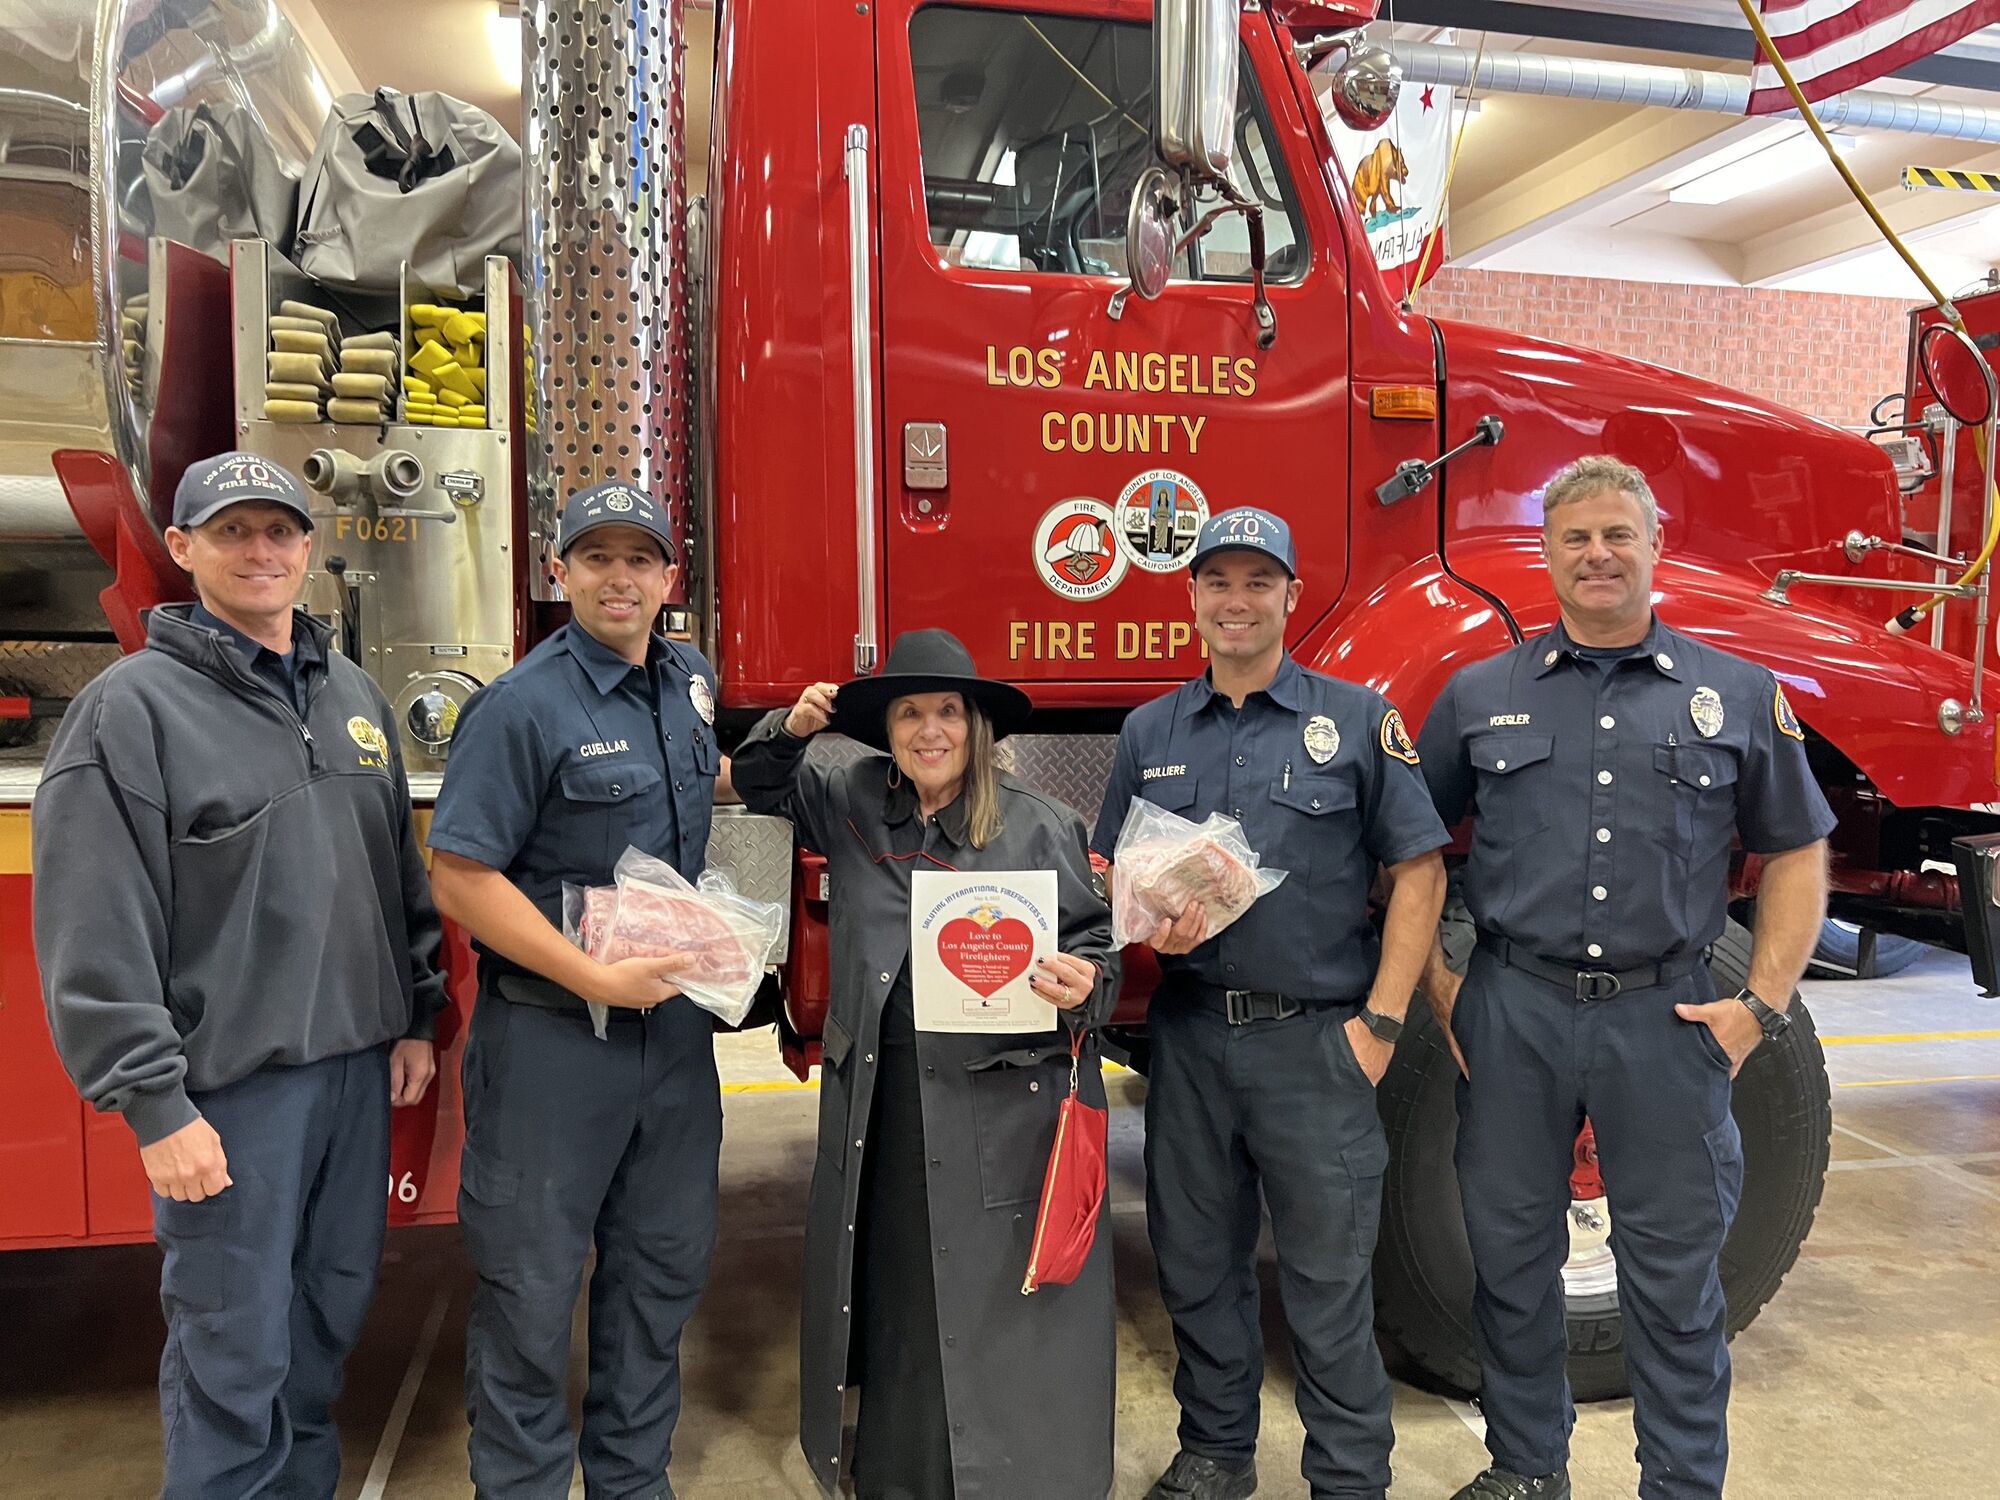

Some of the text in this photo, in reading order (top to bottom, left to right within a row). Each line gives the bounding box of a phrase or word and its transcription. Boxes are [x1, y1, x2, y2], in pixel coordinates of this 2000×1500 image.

[986, 345, 1257, 397] LOS ANGELES
[1041, 411, 1207, 454] COUNTY
[203, 456, 295, 491] LOS ANGELES COUNTY
[229, 464, 270, 481] 70
[218, 479, 248, 491] FIRE
[1121, 472, 1205, 507] COUNTY OF LOS ANGELES
[1073, 503, 1097, 513] FIRE
[336, 515, 417, 541] F0621
[1210, 520, 1222, 533] LOS
[1255, 513, 1280, 534] COUNTY
[1229, 517, 1259, 536] 70
[1137, 557, 1183, 570] CALIFORNIA
[1049, 575, 1113, 595] DEPARTMENT
[1008, 621, 1096, 660] FIRE
[1489, 714, 1531, 727] VOEGLER
[580, 739, 630, 757] CUELLAR
[1143, 764, 1187, 780] SOULLIERE
[922, 900, 946, 930] SALUTING
[945, 885, 999, 904] INTERNATIONAL
[1000, 887, 1041, 918] FIREFIGHTERS
[969, 931, 1002, 940] Love to
[942, 941, 1029, 953] Los Angeles County
[960, 952, 1011, 962] Firefighters
[388, 1171, 418, 1203] 6
